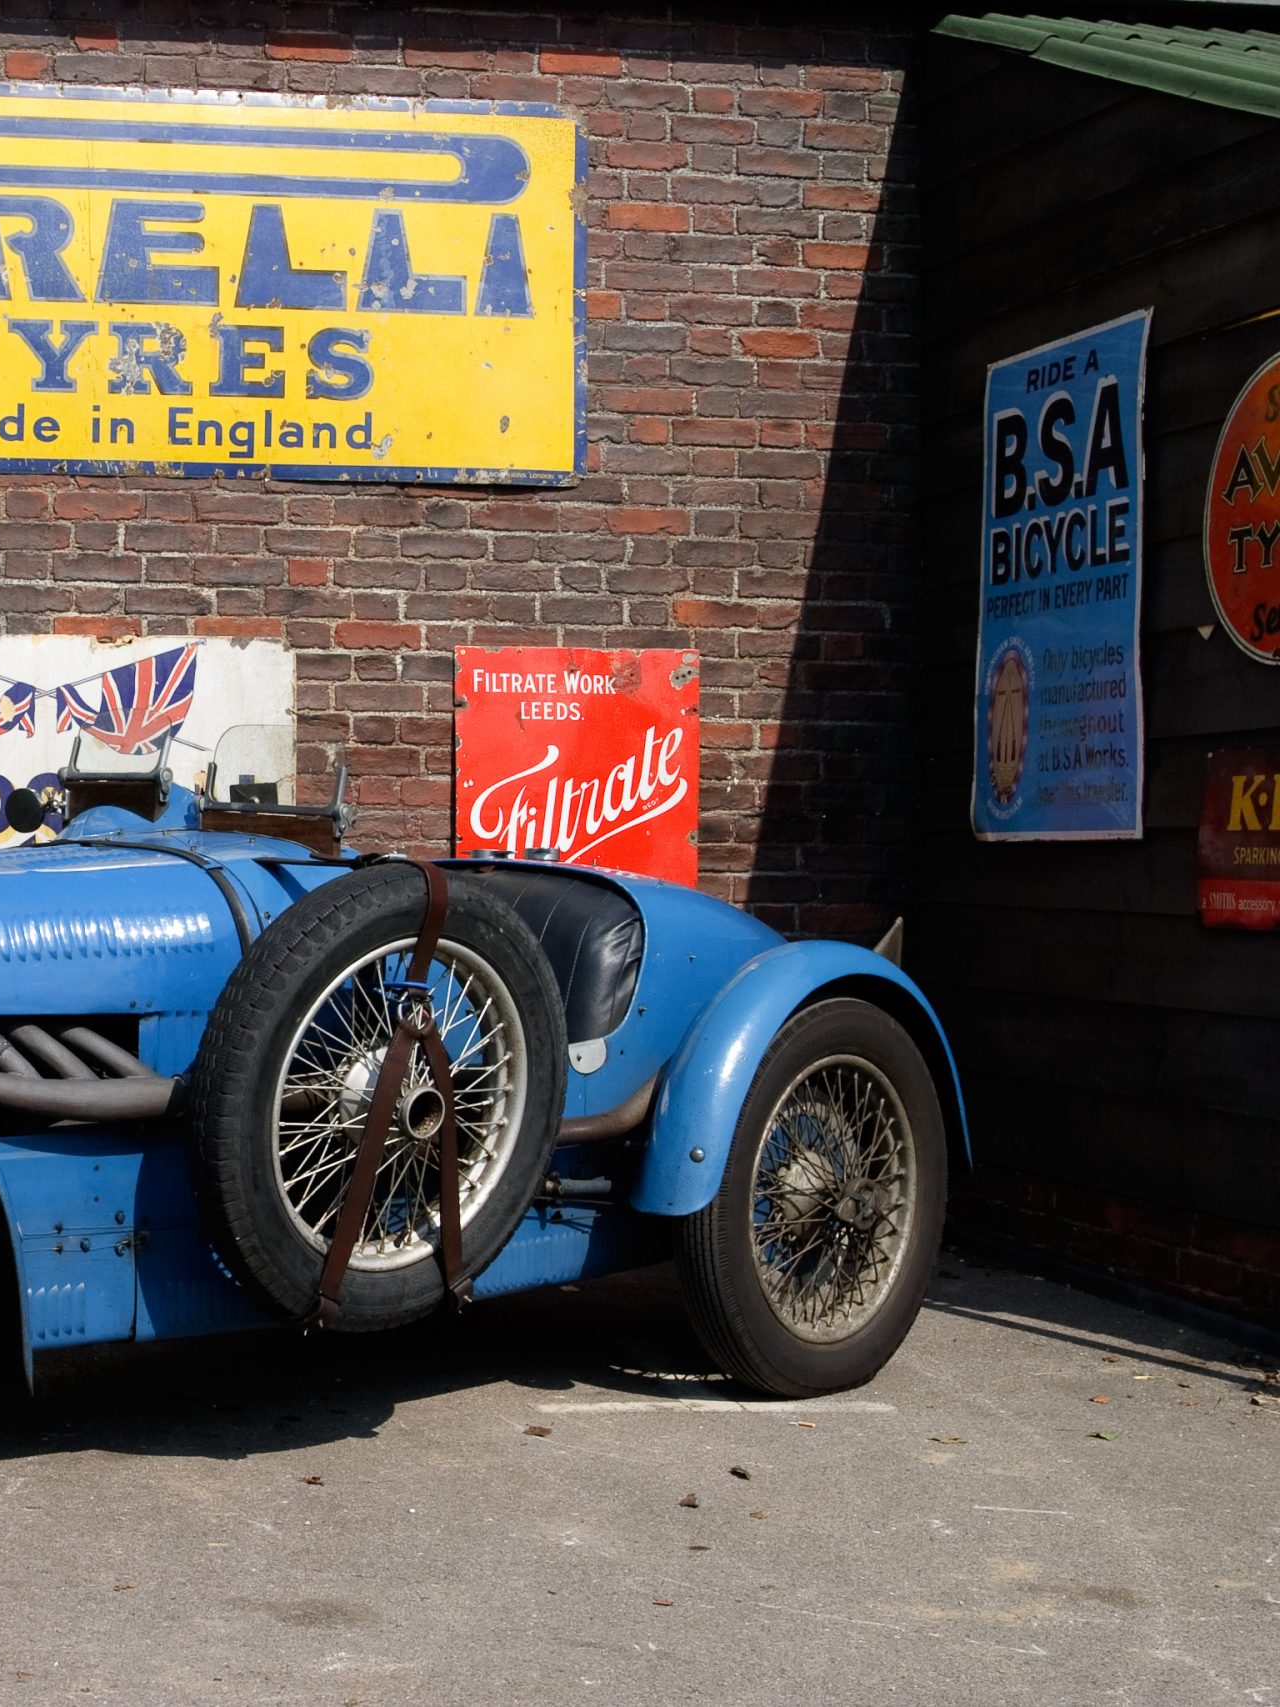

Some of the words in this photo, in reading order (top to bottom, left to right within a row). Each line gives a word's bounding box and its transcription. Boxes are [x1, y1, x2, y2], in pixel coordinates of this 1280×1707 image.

[1026, 355, 1076, 393] RIDE
[1084, 348, 1099, 375] A
[92, 405, 135, 444] in
[168, 406, 375, 459] England
[990, 496, 1130, 586] BICYCLE
[986, 590, 1036, 620] PERFECT
[1039, 586, 1050, 611] IN
[1054, 579, 1093, 609] EVERY
[1095, 573, 1130, 602] PART
[1071, 640, 1124, 676] bicycles
[473, 668, 556, 694] FILTRATE
[520, 701, 584, 721] LEEDS.
[1233, 846, 1280, 865] SPARKIN
